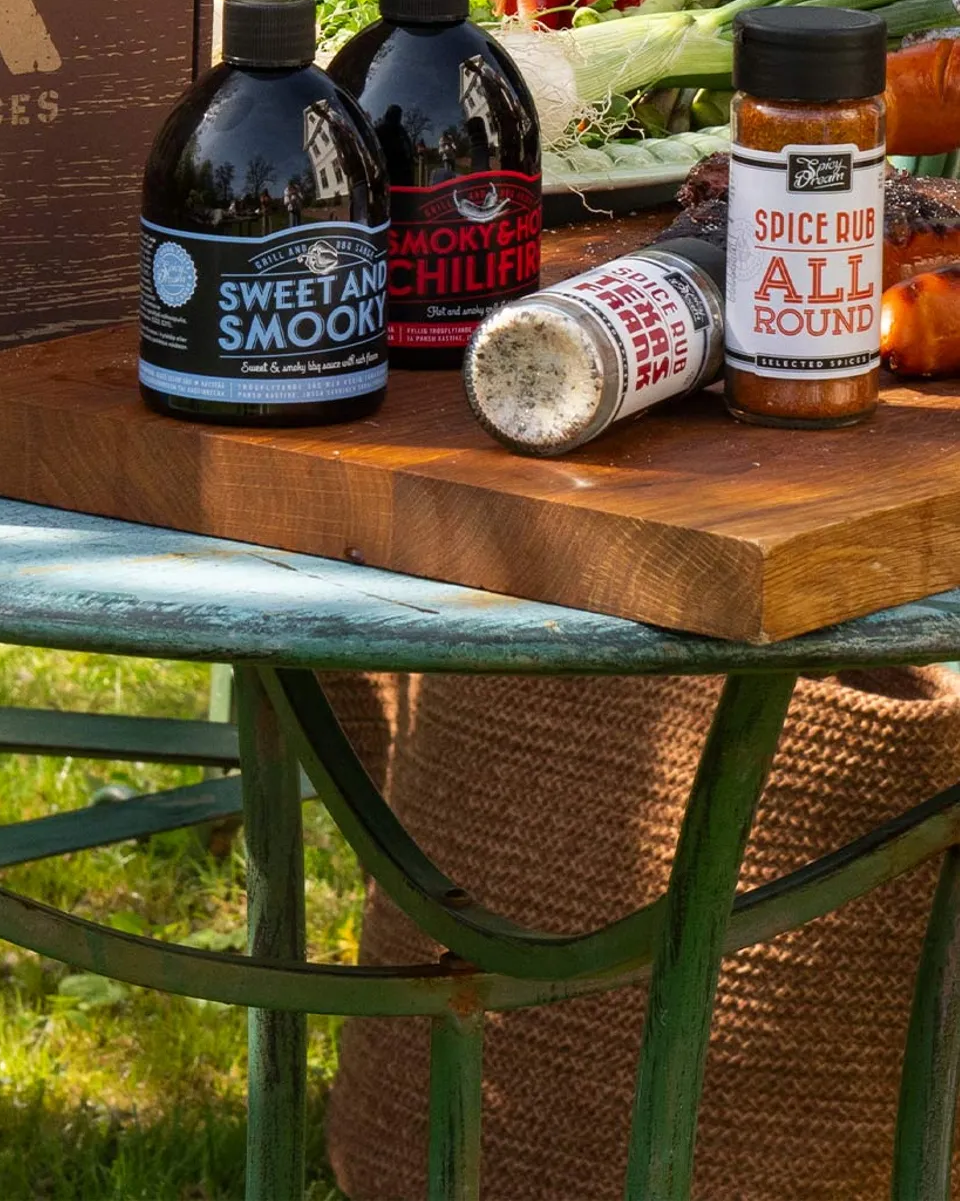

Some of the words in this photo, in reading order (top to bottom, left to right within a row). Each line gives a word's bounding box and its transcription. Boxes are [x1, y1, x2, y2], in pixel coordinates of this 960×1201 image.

[793, 169, 846, 189] Dream
[796, 156, 848, 180] Spicy
[754, 208, 829, 245] SPICE
[836, 206, 875, 244] RUB
[254, 250, 285, 270] GRILL
[288, 243, 308, 257] AND
[388, 240, 542, 296] CHILIFIR
[217, 274, 338, 313] SWEET
[340, 259, 388, 302] AND
[754, 253, 874, 304] ALL
[217, 291, 388, 351] SMOOKY
[595, 274, 670, 385] TEXAS
[611, 266, 678, 317] SPICE
[669, 319, 689, 376] RUB
[753, 303, 874, 337] ROUND
[240, 360, 269, 374] Sweet
[270, 360, 281, 374] &
[282, 361, 307, 375] smoky
[760, 357, 824, 369] SELECTED
[829, 355, 868, 367] SPICES
